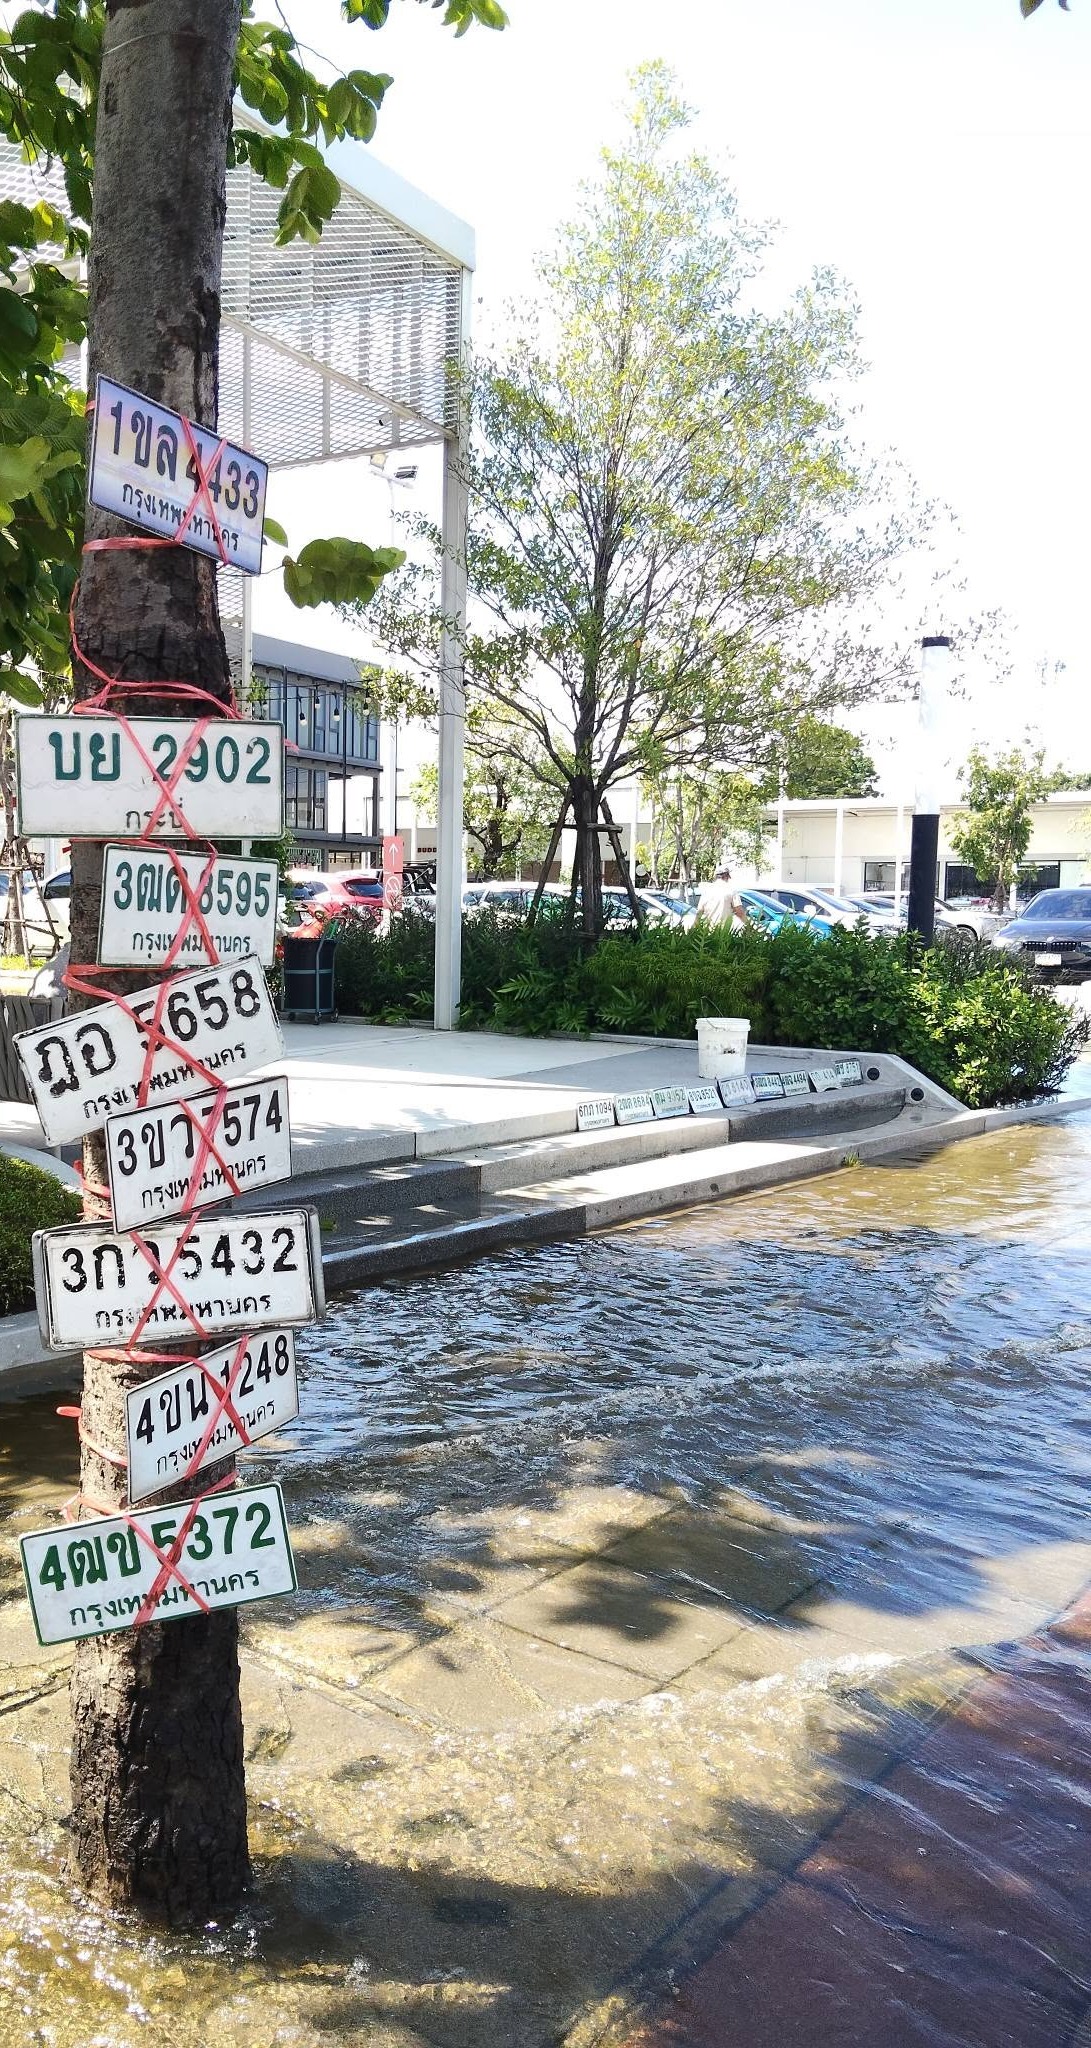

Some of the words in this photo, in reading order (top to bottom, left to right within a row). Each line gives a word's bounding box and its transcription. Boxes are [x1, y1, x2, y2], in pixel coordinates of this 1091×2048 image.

[110, 400, 179, 482] 1ขล
[185, 442, 260, 520] 4433
[48, 731, 121, 782] บย
[152, 734, 271, 784] 2902
[199, 869, 271, 917] 8595
[133, 932, 251, 959] กรุงเทพมานคร
[132, 969, 261, 1052] 5658
[117, 1114, 194, 1176] 3ขว
[141, 1154, 266, 1210] กรุงเทมหานคร
[177, 1227, 298, 1280] 5432
[136, 1372, 209, 1445] 4ขน
[220, 1334, 290, 1401] 1248
[150, 1501, 276, 1569] 5372
